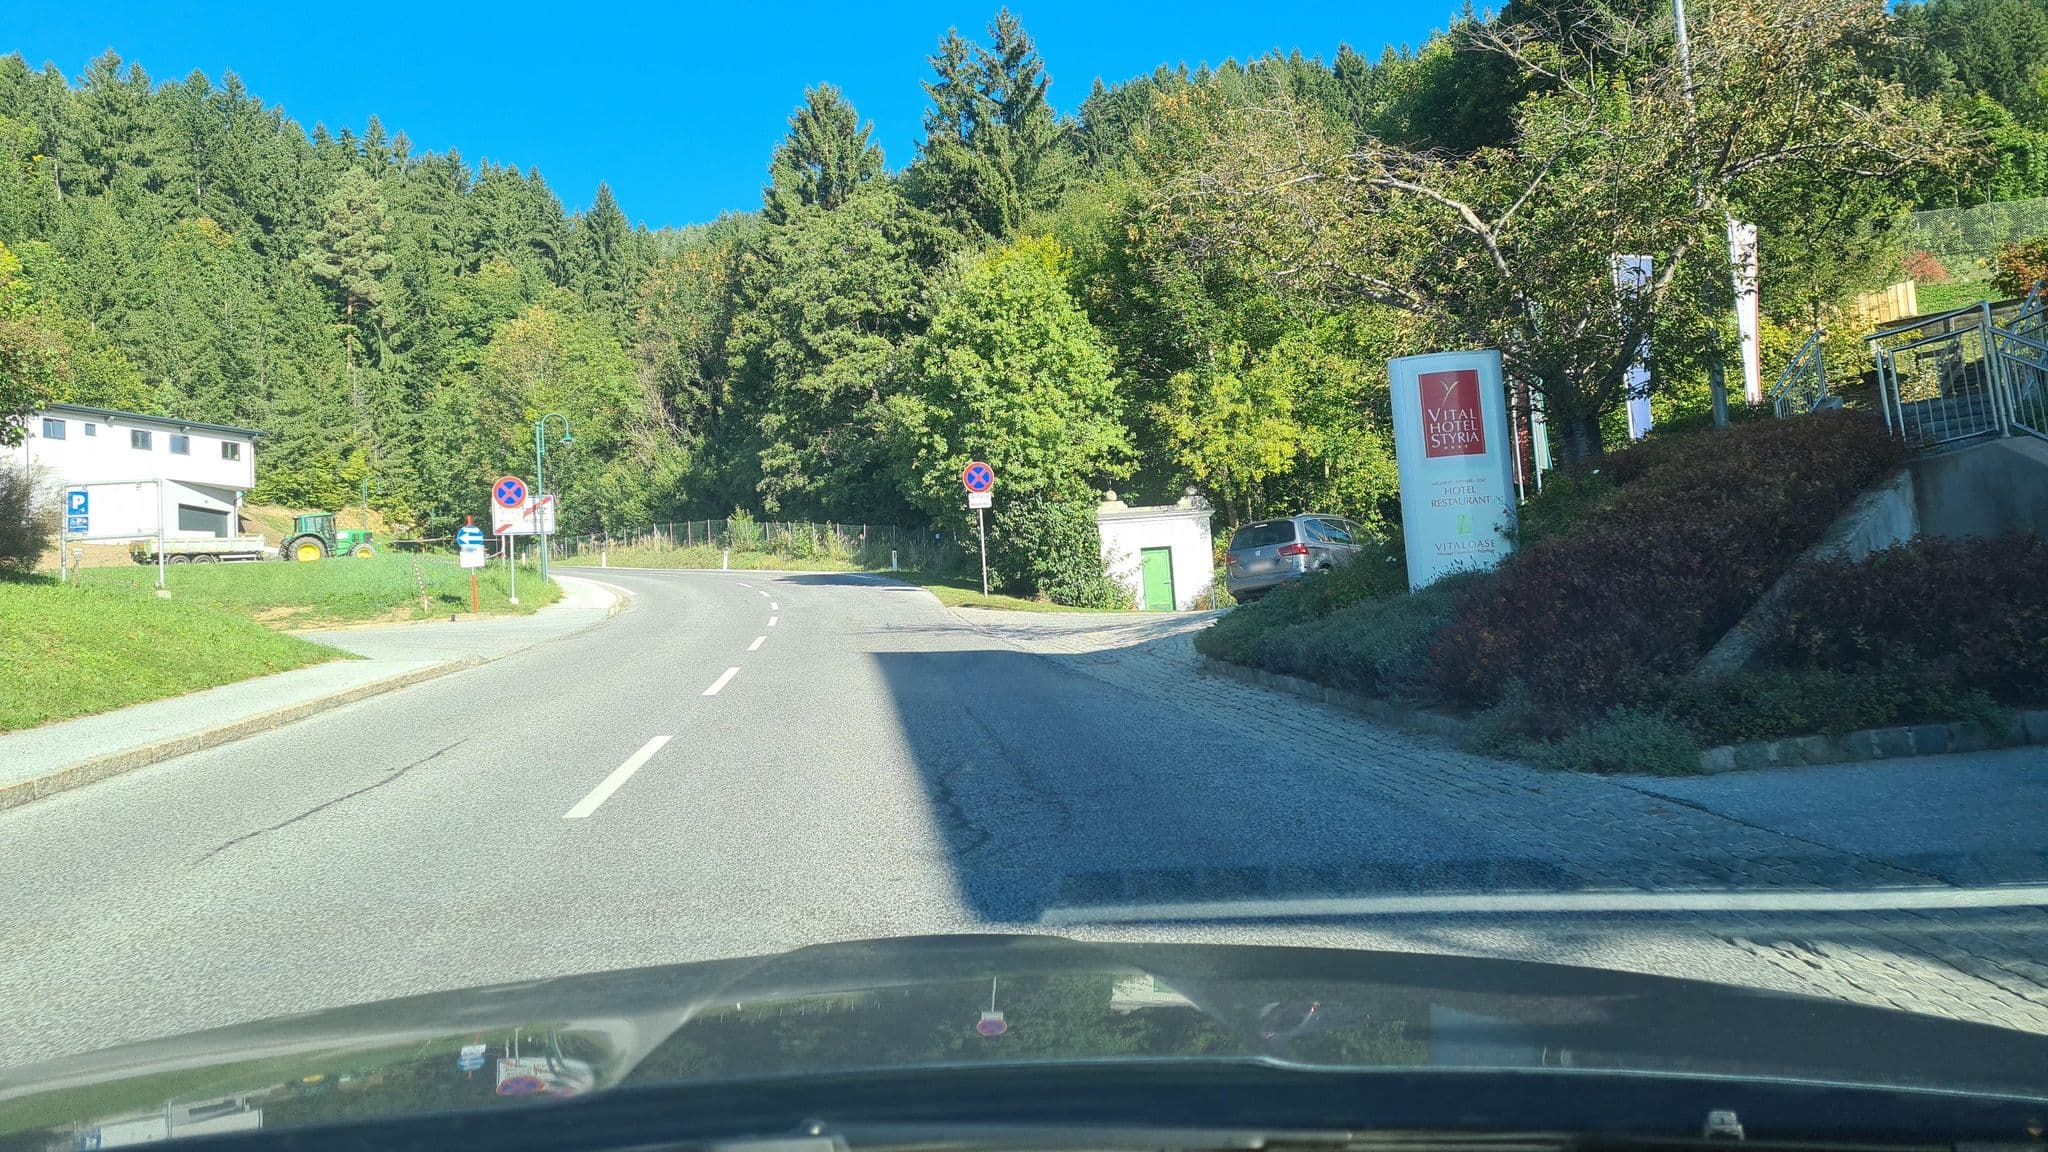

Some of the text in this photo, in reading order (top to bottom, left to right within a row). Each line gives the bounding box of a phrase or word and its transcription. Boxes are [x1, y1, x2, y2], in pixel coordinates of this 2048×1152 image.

[1428, 408, 1477, 421] VITAL
[1430, 420, 1479, 433] HOTEL
[1431, 432, 1479, 448] STYRIA
[1444, 485, 1477, 495] HOTEL
[72, 495, 85, 510] P
[1431, 495, 1491, 508] RESTAURANT
[1434, 539, 1496, 551] VITALOASE
